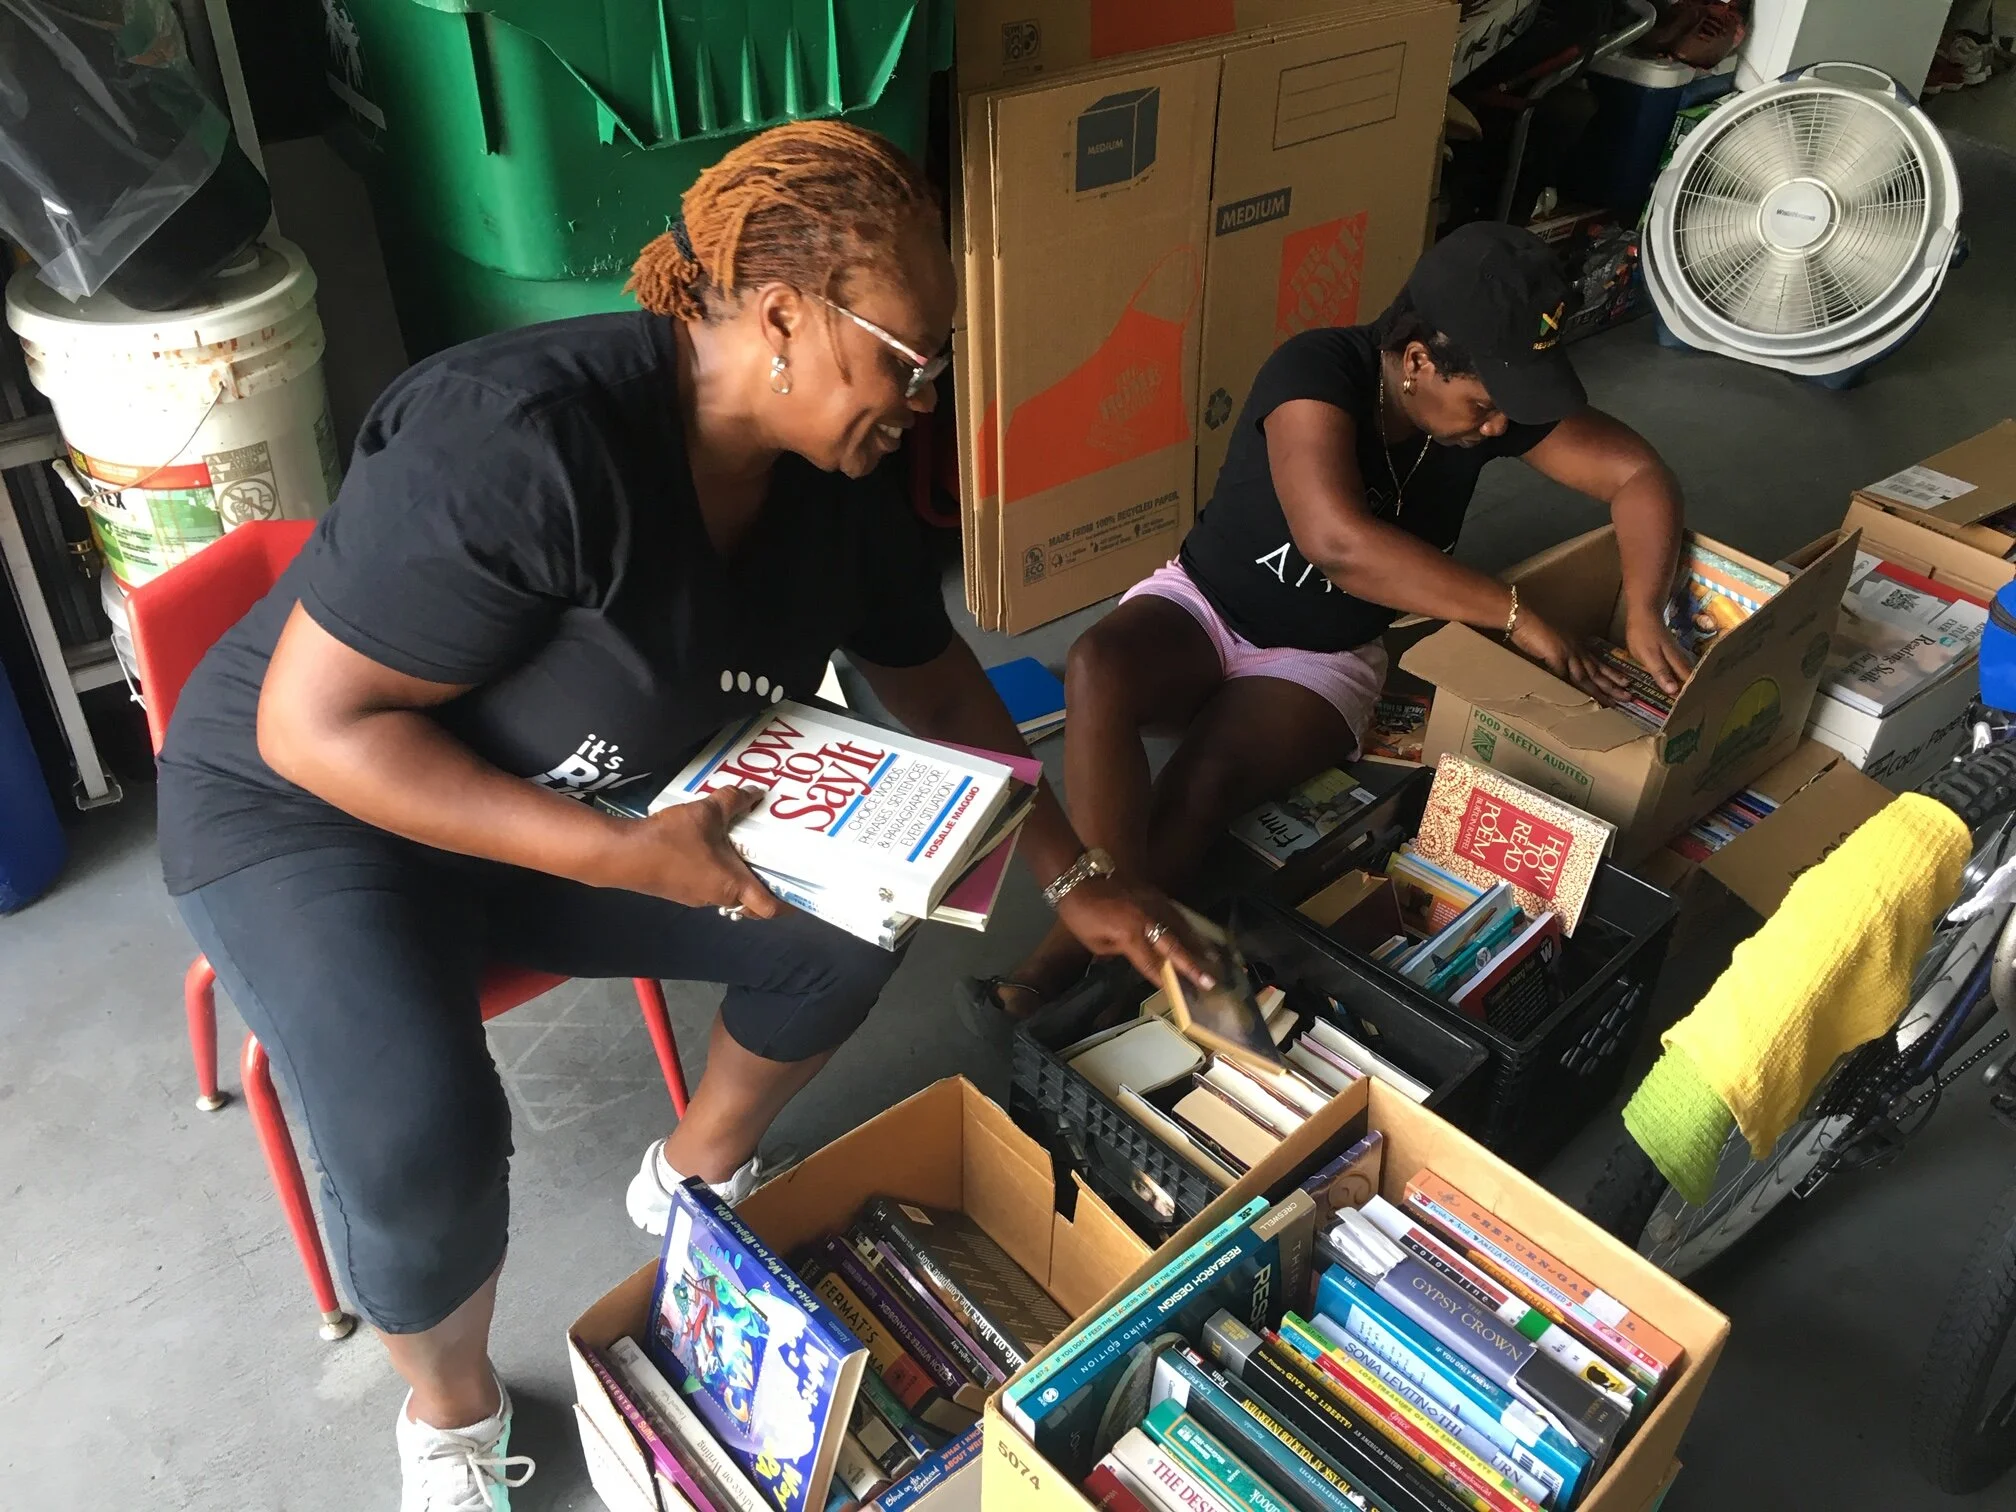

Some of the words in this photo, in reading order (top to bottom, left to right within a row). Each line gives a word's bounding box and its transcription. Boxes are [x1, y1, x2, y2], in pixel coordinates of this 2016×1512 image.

[1088, 139, 1123, 156] MEDIUM
[1221, 195, 1285, 230] MEDIUM
[1048, 532, 1071, 547] MADE
[1072, 521, 1095, 538] FROM
[1095, 516, 1116, 529] 100%
[1117, 501, 1153, 522] RECYCLED
[1025, 563, 1045, 577] ECO
[1860, 654, 1879, 665] for
[1883, 633, 1937, 666] Reading
[1858, 660, 1896, 684] Skills
[577, 733, 624, 770] it's
[1473, 709, 1502, 732] FOOD
[1502, 728, 1542, 757] SAFETY
[1542, 753, 1589, 786] AUDITED
[768, 752, 824, 784] to
[769, 761, 873, 832] Say
[848, 794, 881, 831] CHOICE
[878, 767, 907, 799] WORDS,
[858, 807, 894, 845] PHRASES,
[891, 763, 928, 809] SENTENCES
[877, 840, 891, 849] &
[888, 790, 931, 842] PARAGRAPHS
[927, 769, 944, 792] FOR
[1471, 797, 1483, 827] BURTON
[900, 820, 926, 847] EVERY
[920, 782, 956, 822] SITUATION
[924, 820, 957, 859] ROSALIE
[952, 786, 981, 821] MAGGIO
[1257, 812, 1303, 849] Finn
[1462, 824, 1475, 852] RAFFEL
[1471, 801, 1501, 861] POEM
[1491, 828, 1508, 845] A
[1503, 819, 1533, 874] READ
[1522, 841, 1546, 870] TO
[1535, 835, 1565, 890] HOW
[713, 1203, 734, 1223] GPA
[1259, 1202, 1298, 1231] CRESWELL
[1429, 1204, 1448, 1220] Parish
[731, 1220, 757, 1249] Higher
[752, 1241, 761, 1250] a
[1204, 1227, 1229, 1247] CONNORS
[757, 1246, 769, 1258] to
[915, 1249, 935, 1272] Story
[1192, 1245, 1242, 1287] RESEARCH
[764, 1257, 783, 1280] Way
[780, 1272, 800, 1293] Your
[1343, 1275, 1357, 1289] VAIL
[1411, 1243, 1451, 1273] color
[1458, 1277, 1489, 1303] line
[1479, 1239, 1503, 1259] AMELIA
[1502, 1256, 1530, 1278] BEDELIA
[1529, 1270, 1567, 1304] UNLEASHED
[1480, 1219, 1549, 1269] RETURN
[1556, 1272, 1636, 1332] GABL
[796, 1284, 820, 1313] Write
[932, 1269, 961, 1303] Complete
[1157, 1281, 1195, 1314] DESIGN
[1492, 1267, 1513, 1285] CITY
[1522, 1290, 1556, 1316] EMBER
[819, 1279, 879, 1344] FERMAT'S
[879, 1299, 907, 1334] HANDBOOK
[958, 1299, 976, 1321] The
[1061, 1347, 1074, 1360] YOU
[1073, 1335, 1090, 1350] DON'T
[1088, 1324, 1102, 1338] FEED
[1101, 1316, 1113, 1330] THE
[1111, 1296, 1139, 1321] TEACHERS
[1137, 1286, 1152, 1302] THEY
[1150, 1279, 1162, 1291] EAT
[1160, 1271, 1172, 1282] THE
[1412, 1277, 1462, 1315] GYPSY
[1461, 1312, 1523, 1361] CROWN
[1466, 1302, 1483, 1316] THE
[970, 1313, 996, 1342] Mars
[994, 1336, 1007, 1351] on
[1122, 1315, 1153, 1340] THIRD
[906, 1331, 932, 1364] WRITER'S
[951, 1340, 961, 1352] sky
[959, 1349, 971, 1364] night
[1004, 1346, 1028, 1372] Life
[1080, 1340, 1121, 1374] EDITION
[1176, 1362, 1215, 1395] LAUREATE
[1211, 1370, 1229, 1388] Fein
[1345, 1342, 1382, 1375] SONIA
[1383, 1371, 1430, 1411] LEVITIN
[1434, 1345, 1443, 1354] IF
[1441, 1350, 1455, 1364] YOU
[1453, 1359, 1472, 1377] ONLY
[1470, 1371, 1493, 1391] KNEW
[599, 1369, 633, 1412] ELEMENTS
[637, 1419, 657, 1442] Sulfur
[1285, 1372, 1306, 1391] GIVE
[1304, 1388, 1319, 1402] ME
[1317, 1399, 1353, 1430] LIBERTY!
[1241, 1398, 1283, 1437] INTERVIEW
[1358, 1368, 1377, 1384] LOST
[1375, 1382, 1413, 1413] TREASURE
[1413, 1412, 1425, 1422] OF
[1425, 1421, 1442, 1435] THE
[1440, 1433, 1477, 1462] EMERALD
[1476, 1460, 1493, 1475] EYE
[1388, 1410, 1410, 1431] Grace
[940, 1443, 962, 1460] WHAT
[1281, 1430, 1299, 1452] JOB
[1293, 1442, 1315, 1464] YOUR
[1353, 1429, 1363, 1440] AN
[1360, 1434, 1385, 1457] AMERICAN
[1383, 1452, 1404, 1472] HISTORY
[696, 1439, 723, 1476] Writing
[943, 1450, 968, 1472] ABOUT
[998, 1440, 1041, 1490] 5074
[1313, 1457, 1326, 1474] AT
[721, 1471, 733, 1486] on
[885, 1490, 905, 1507] Blood
[903, 1482, 912, 1492] on
[910, 1475, 922, 1486] the
[1152, 1459, 1180, 1492] THE
[1322, 1467, 1340, 1486] ASK
[1336, 1479, 1351, 1496] TO
